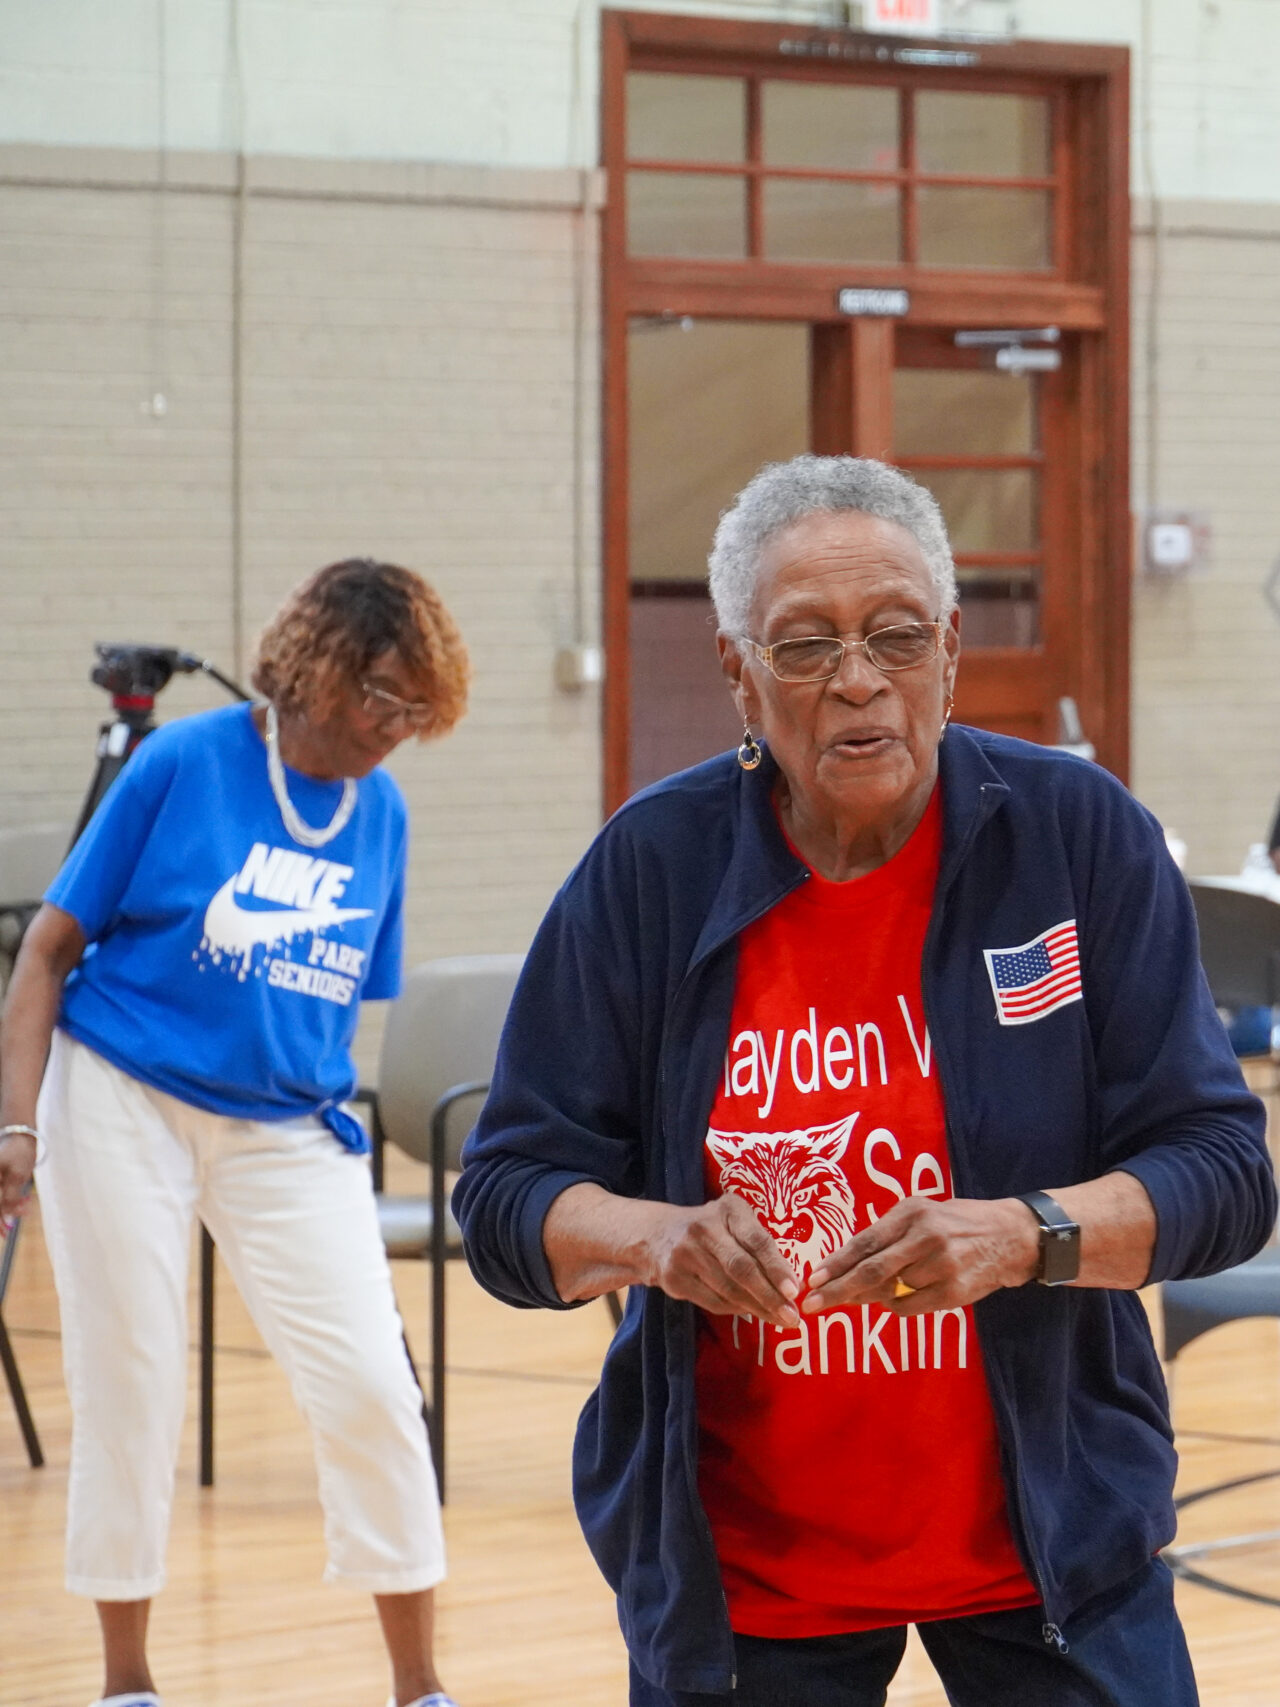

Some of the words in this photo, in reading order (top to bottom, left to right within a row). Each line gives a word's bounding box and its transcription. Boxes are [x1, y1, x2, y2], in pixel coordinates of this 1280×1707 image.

[236, 842, 354, 910] NIKE
[267, 958, 356, 1006] SENIORS
[308, 937, 366, 977] PARK
[724, 1007, 889, 1120] ayden
